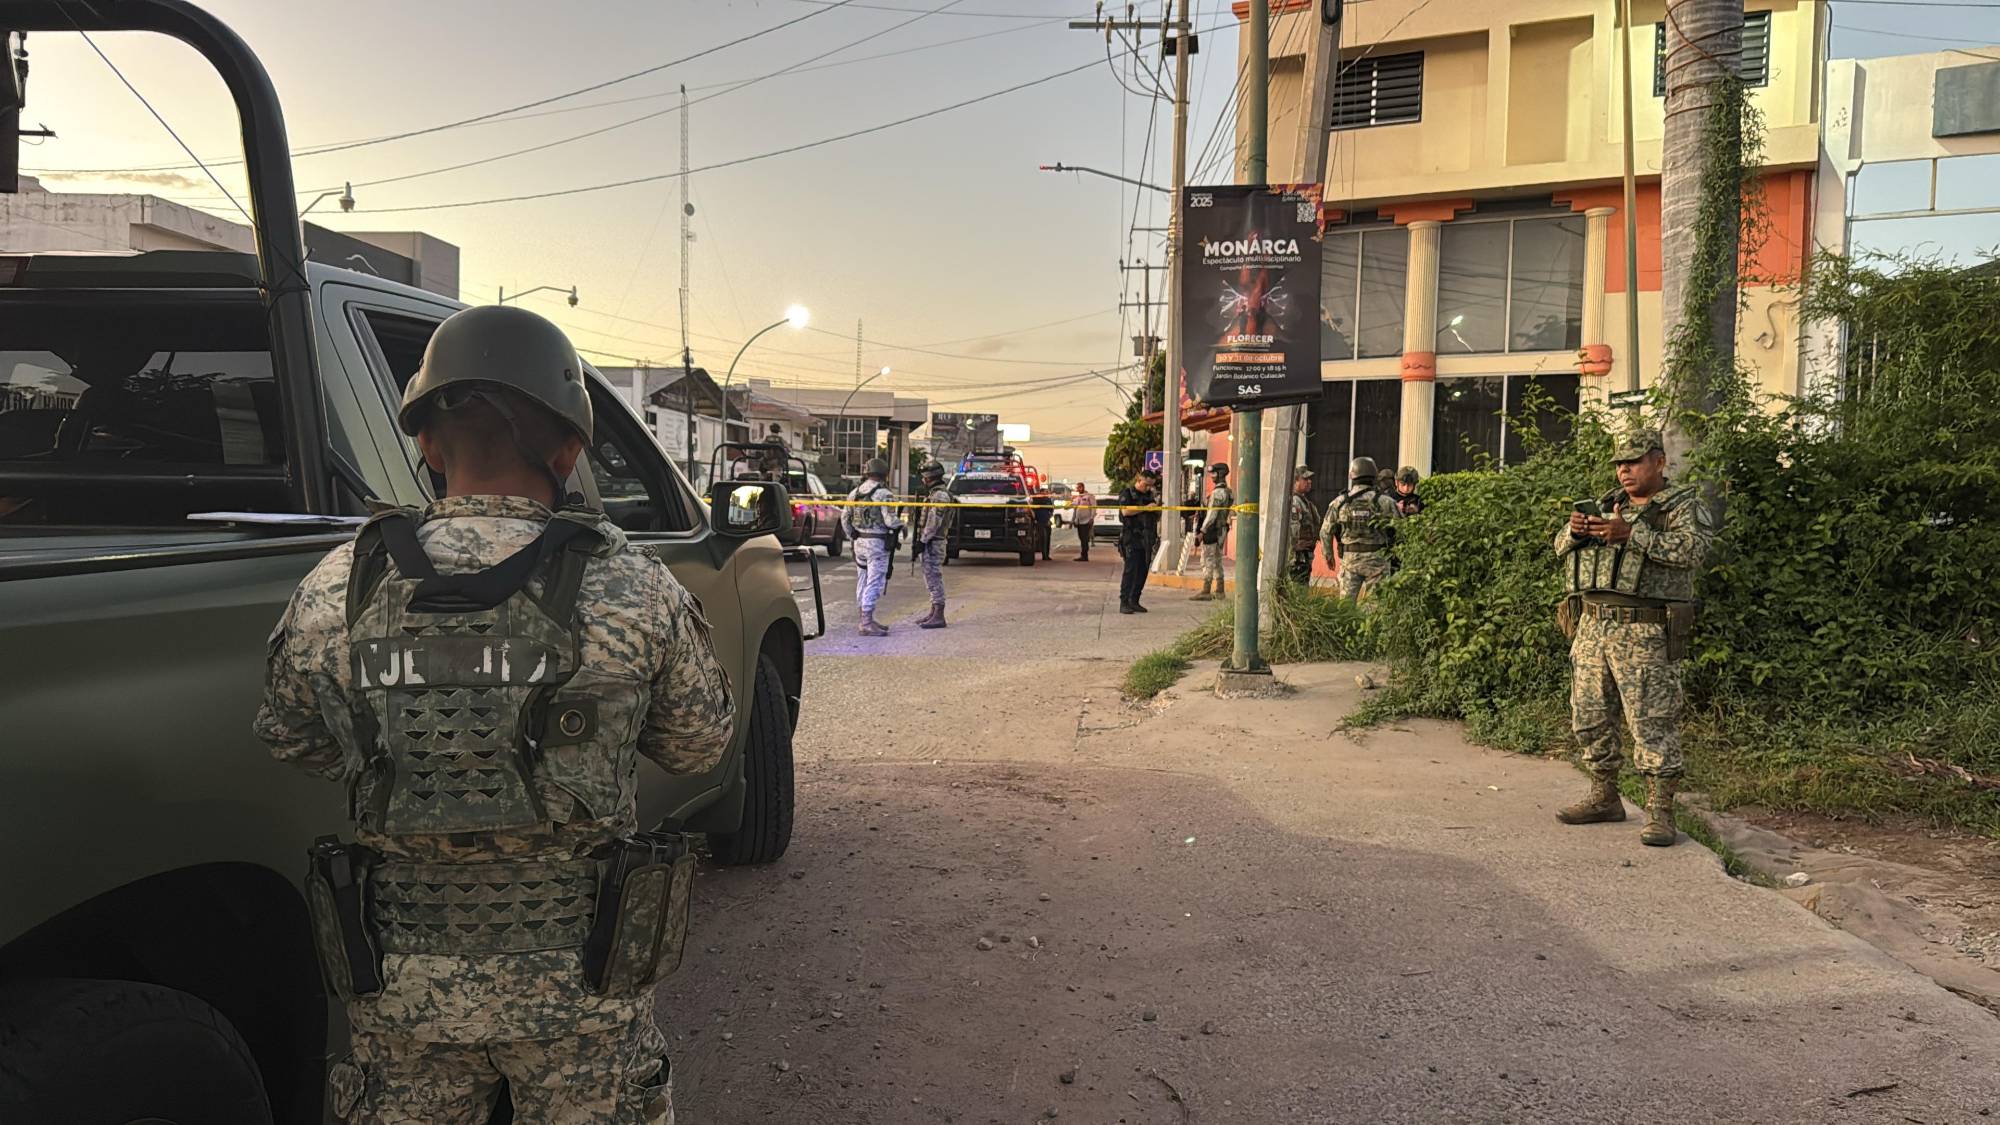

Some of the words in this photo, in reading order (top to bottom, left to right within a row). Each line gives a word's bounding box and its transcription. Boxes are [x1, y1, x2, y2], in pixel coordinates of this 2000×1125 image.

[1190, 196, 1214, 207] 2025
[1204, 239, 1300, 256] MONARCA
[1202, 256, 1244, 266] Espectáculo
[1245, 254, 1302, 264] multidisciplinario
[1227, 335, 1274, 343] FLORECER
[1238, 384, 1261, 395] SAS
